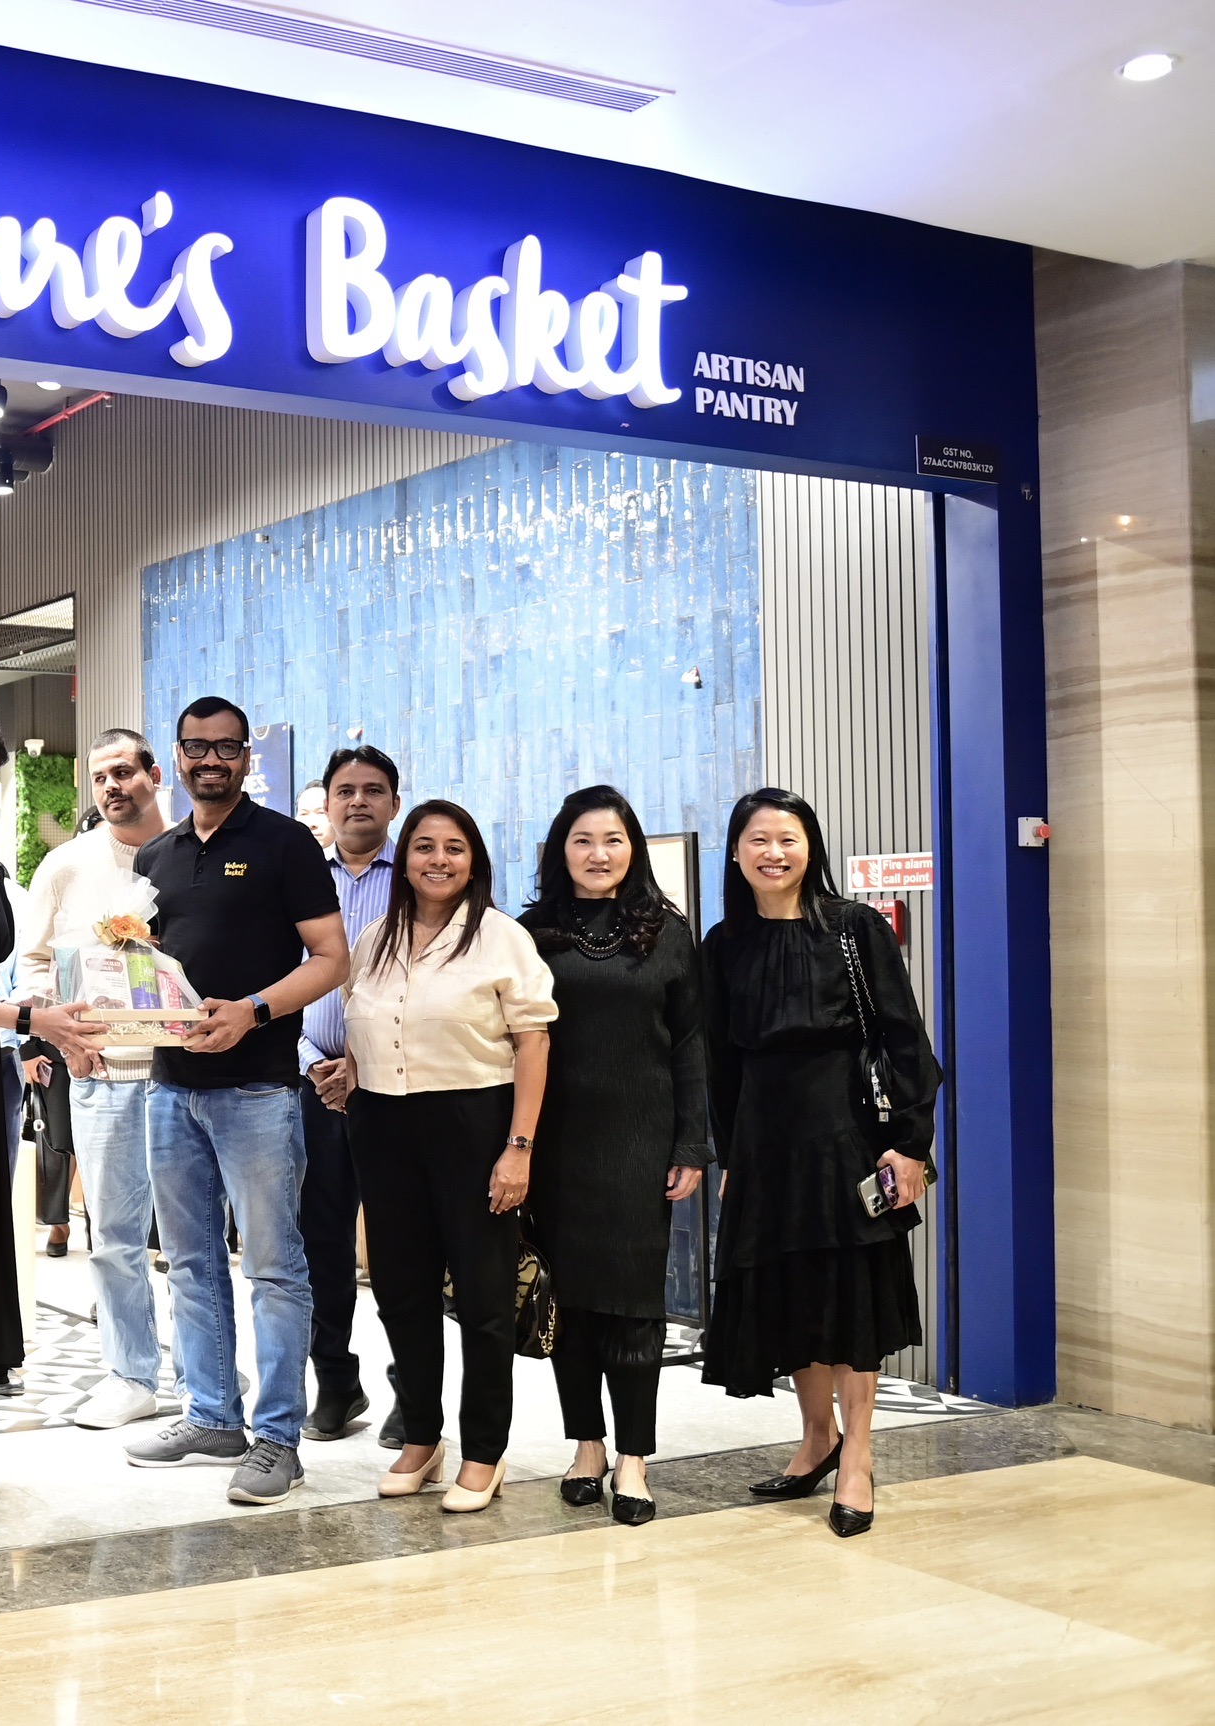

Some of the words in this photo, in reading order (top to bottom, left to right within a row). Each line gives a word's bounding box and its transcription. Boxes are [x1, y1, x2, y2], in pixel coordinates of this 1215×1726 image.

[305, 196, 689, 409] Basket
[693, 351, 805, 393] ARTISAN
[695, 386, 799, 427] PANTRY
[942, 446, 959, 457] GST
[959, 449, 974, 459] NO.
[882, 859, 903, 870] Fire
[904, 857, 933, 869] alarm
[882, 873, 901, 884] call
[903, 872, 930, 885] point
